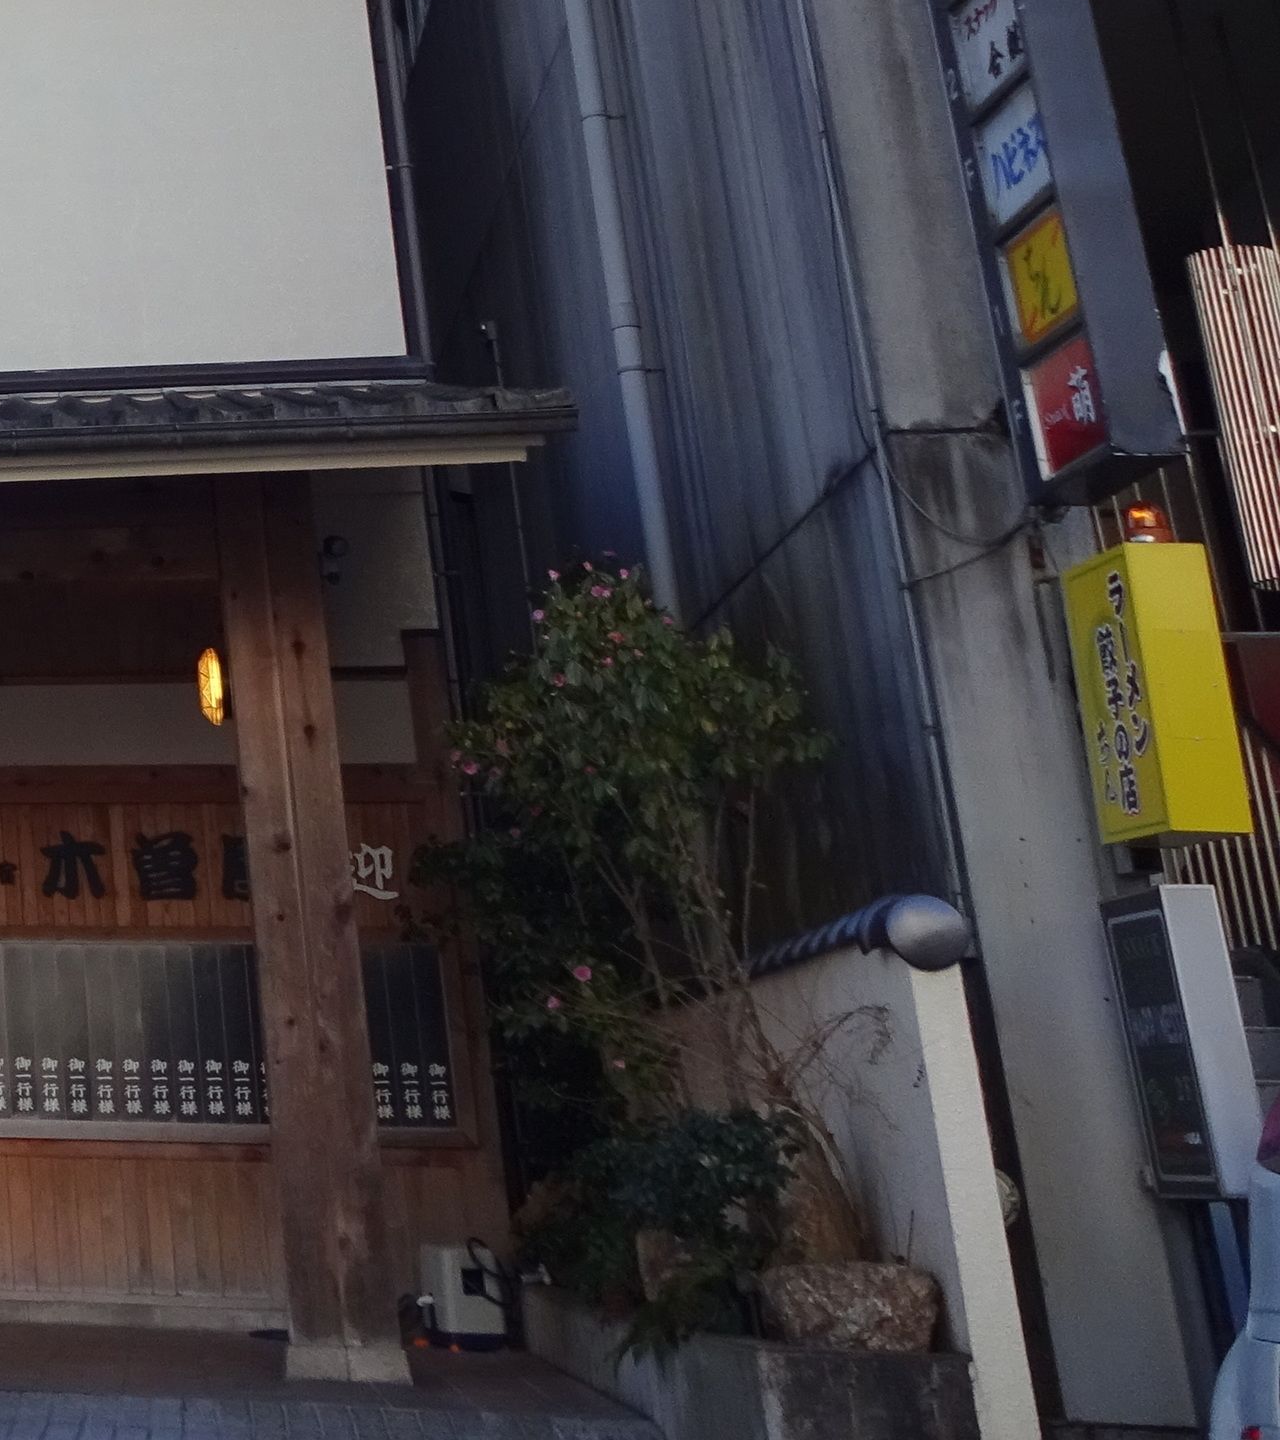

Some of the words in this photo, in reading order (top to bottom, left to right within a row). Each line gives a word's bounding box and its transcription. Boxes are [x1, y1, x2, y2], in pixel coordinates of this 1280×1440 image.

[1107, 571, 1149, 757] ラーメン
[15, 1057, 33, 1112] 御一行様
[42, 1058, 60, 1112] 御一行様
[69, 1057, 87, 1113] 御一行様
[96, 1059, 114, 1113] 御一行様
[123, 1059, 142, 1114] 御一行様
[151, 1059, 170, 1115] 御一行様
[177, 1060, 197, 1115] 御一行様
[206, 1060, 224, 1115] 御一行様
[233, 1060, 252, 1115] 御一行様
[373, 1063, 393, 1118] 御一行様
[401, 1063, 422, 1118] 御一行様
[429, 1064, 450, 1119] 御一行様
